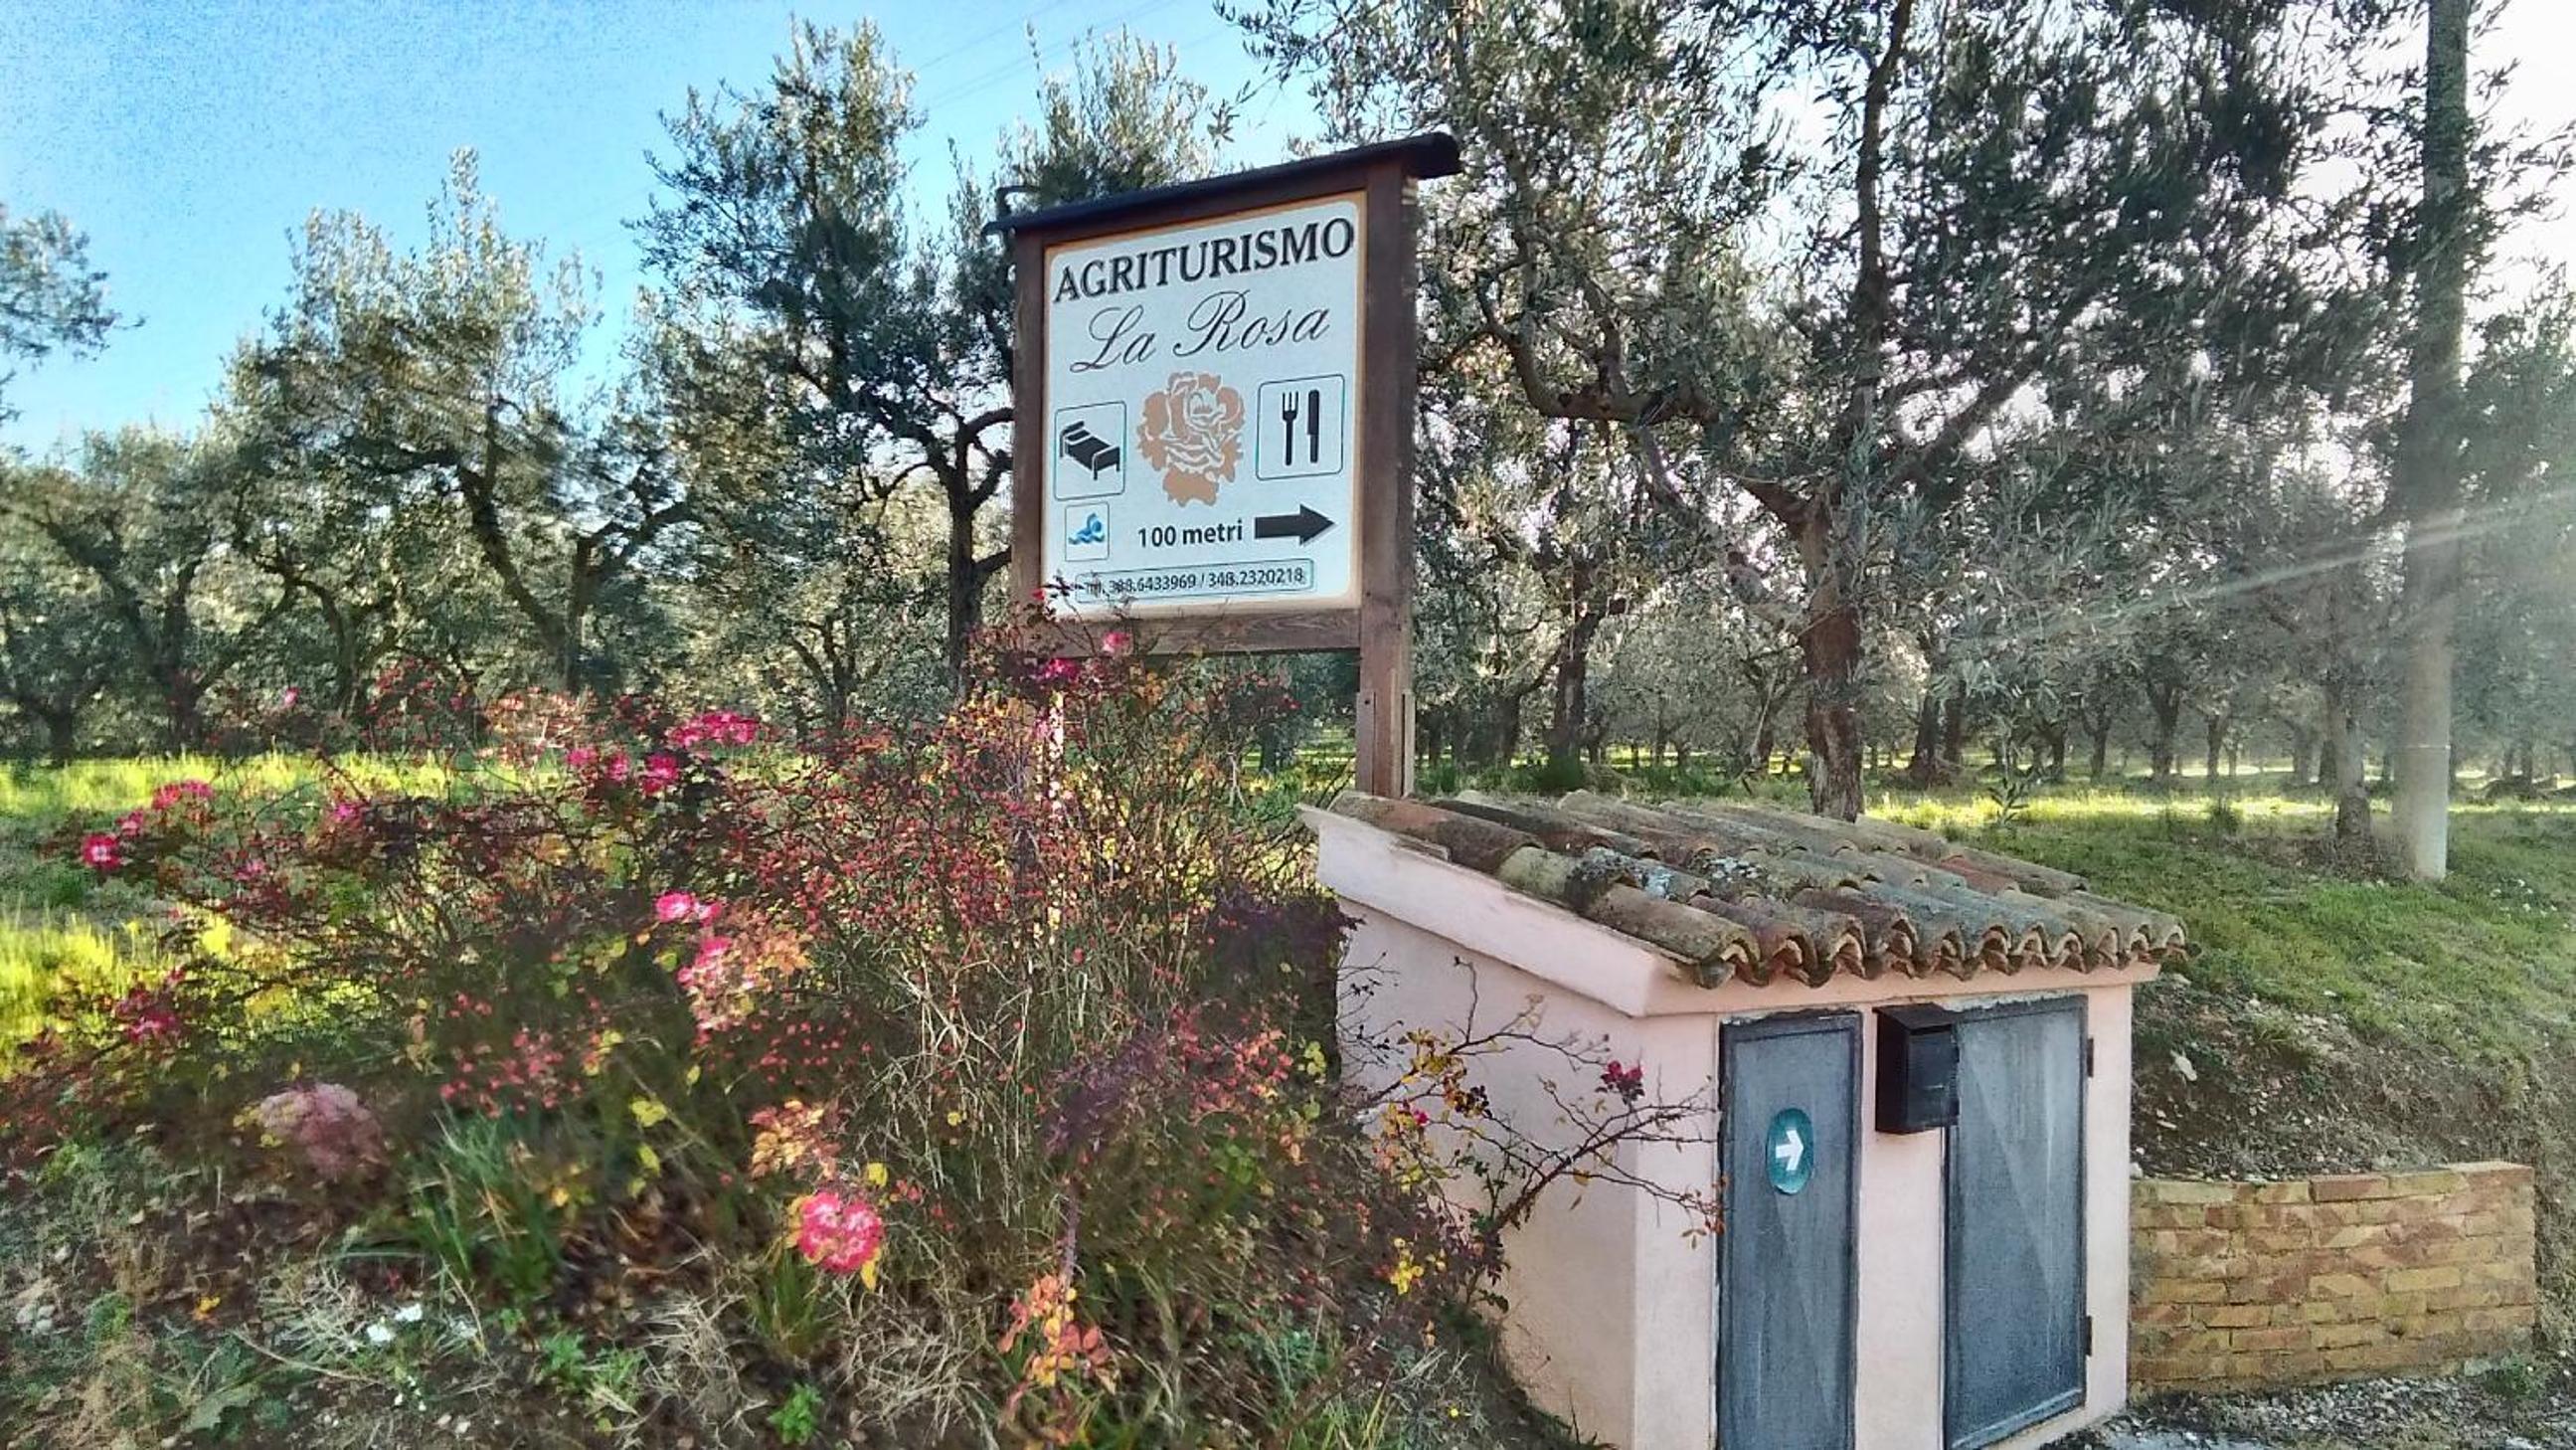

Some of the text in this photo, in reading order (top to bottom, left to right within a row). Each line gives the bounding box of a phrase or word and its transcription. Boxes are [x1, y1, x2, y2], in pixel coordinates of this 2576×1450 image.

[1053, 217, 1354, 303] AGRITURISMO
[1070, 288, 1330, 373] La Rosa
[1138, 518, 1243, 548] 100 metri
